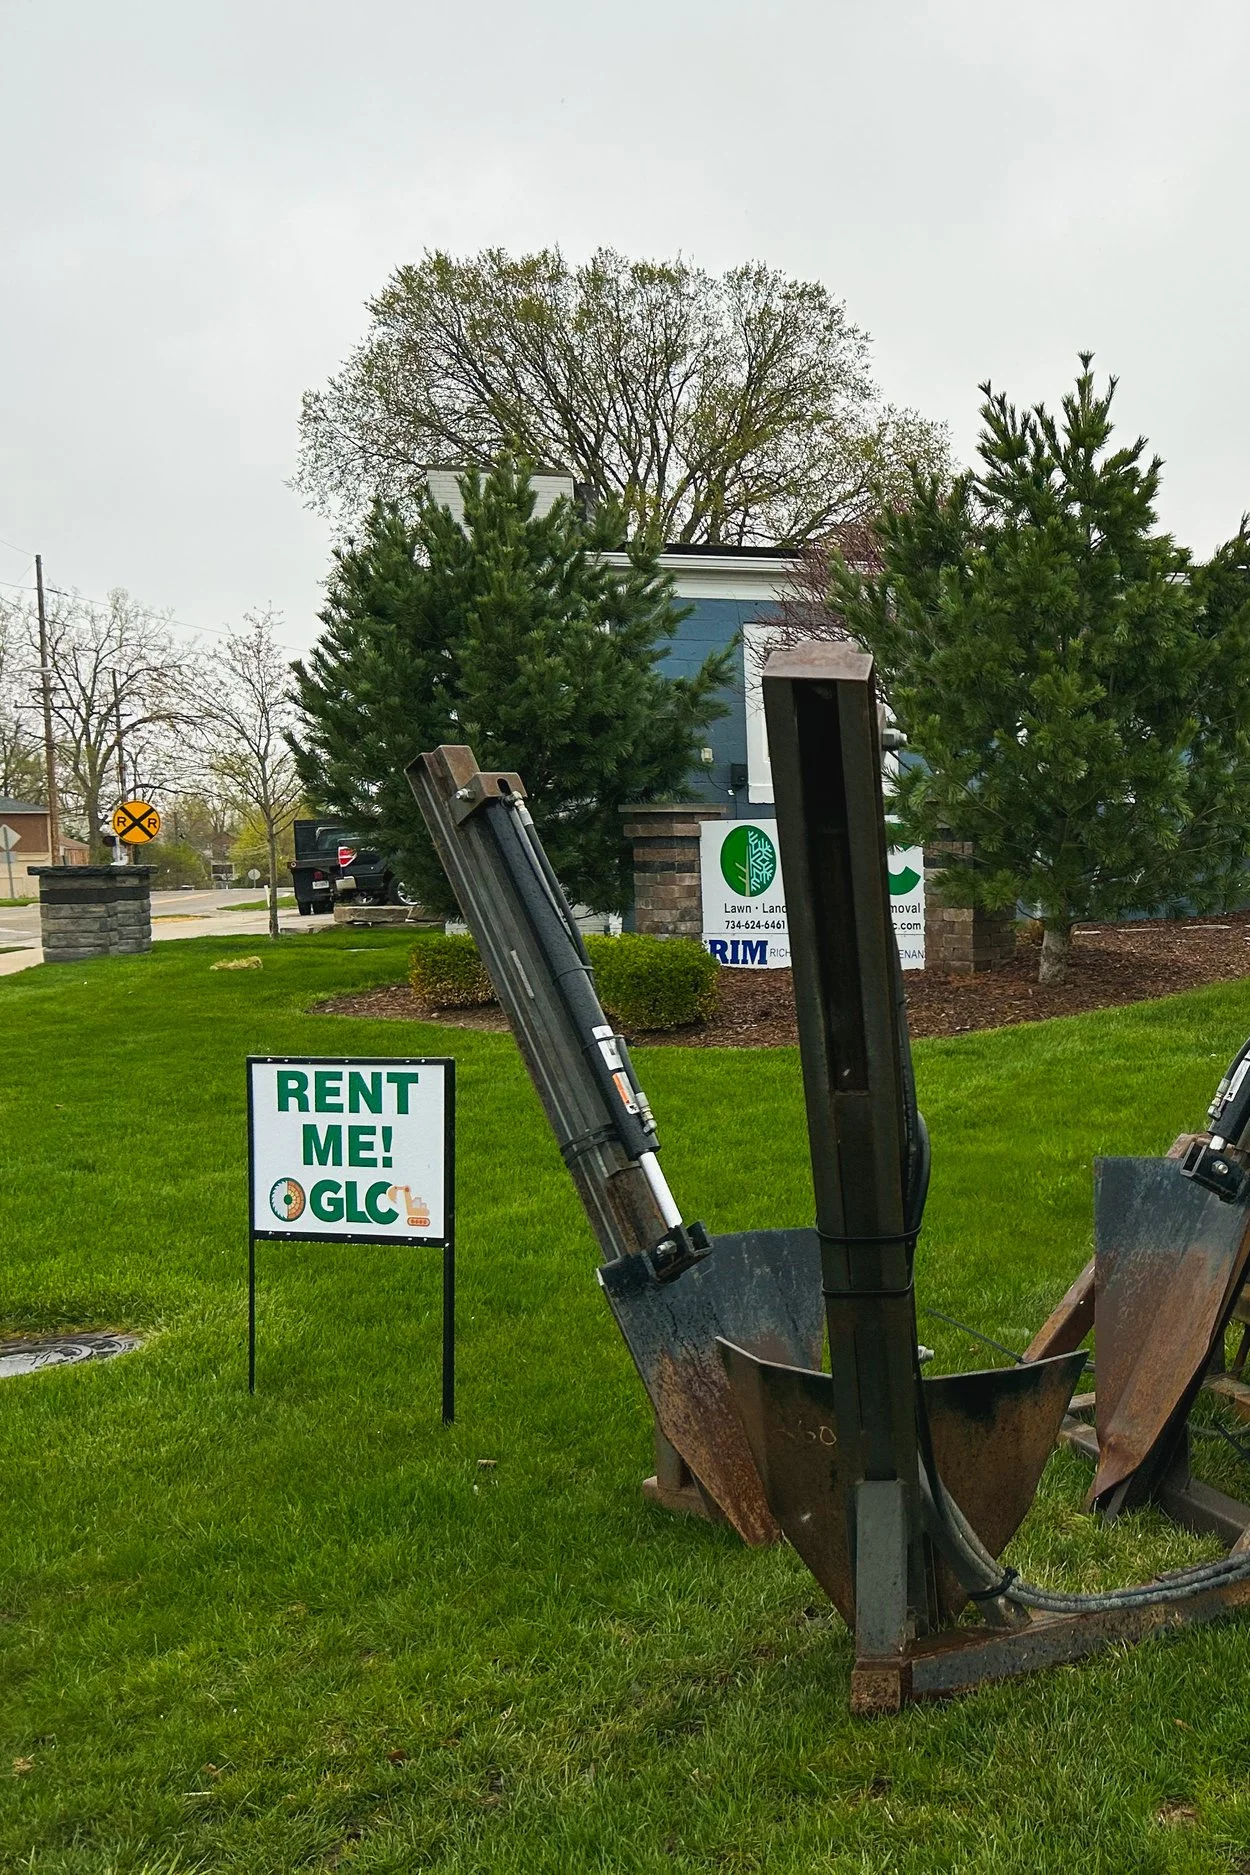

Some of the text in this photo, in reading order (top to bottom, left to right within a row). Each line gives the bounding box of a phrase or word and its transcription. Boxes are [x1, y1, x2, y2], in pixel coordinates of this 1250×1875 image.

[117, 816, 157, 828] R R
[724, 902, 752, 914] Lawn
[725, 920, 786, 930] 734-624-6461
[708, 939, 769, 965] RIM
[276, 1070, 419, 1115] RENT
[302, 1124, 393, 1169] ME!
[309, 1179, 400, 1225] GLC
